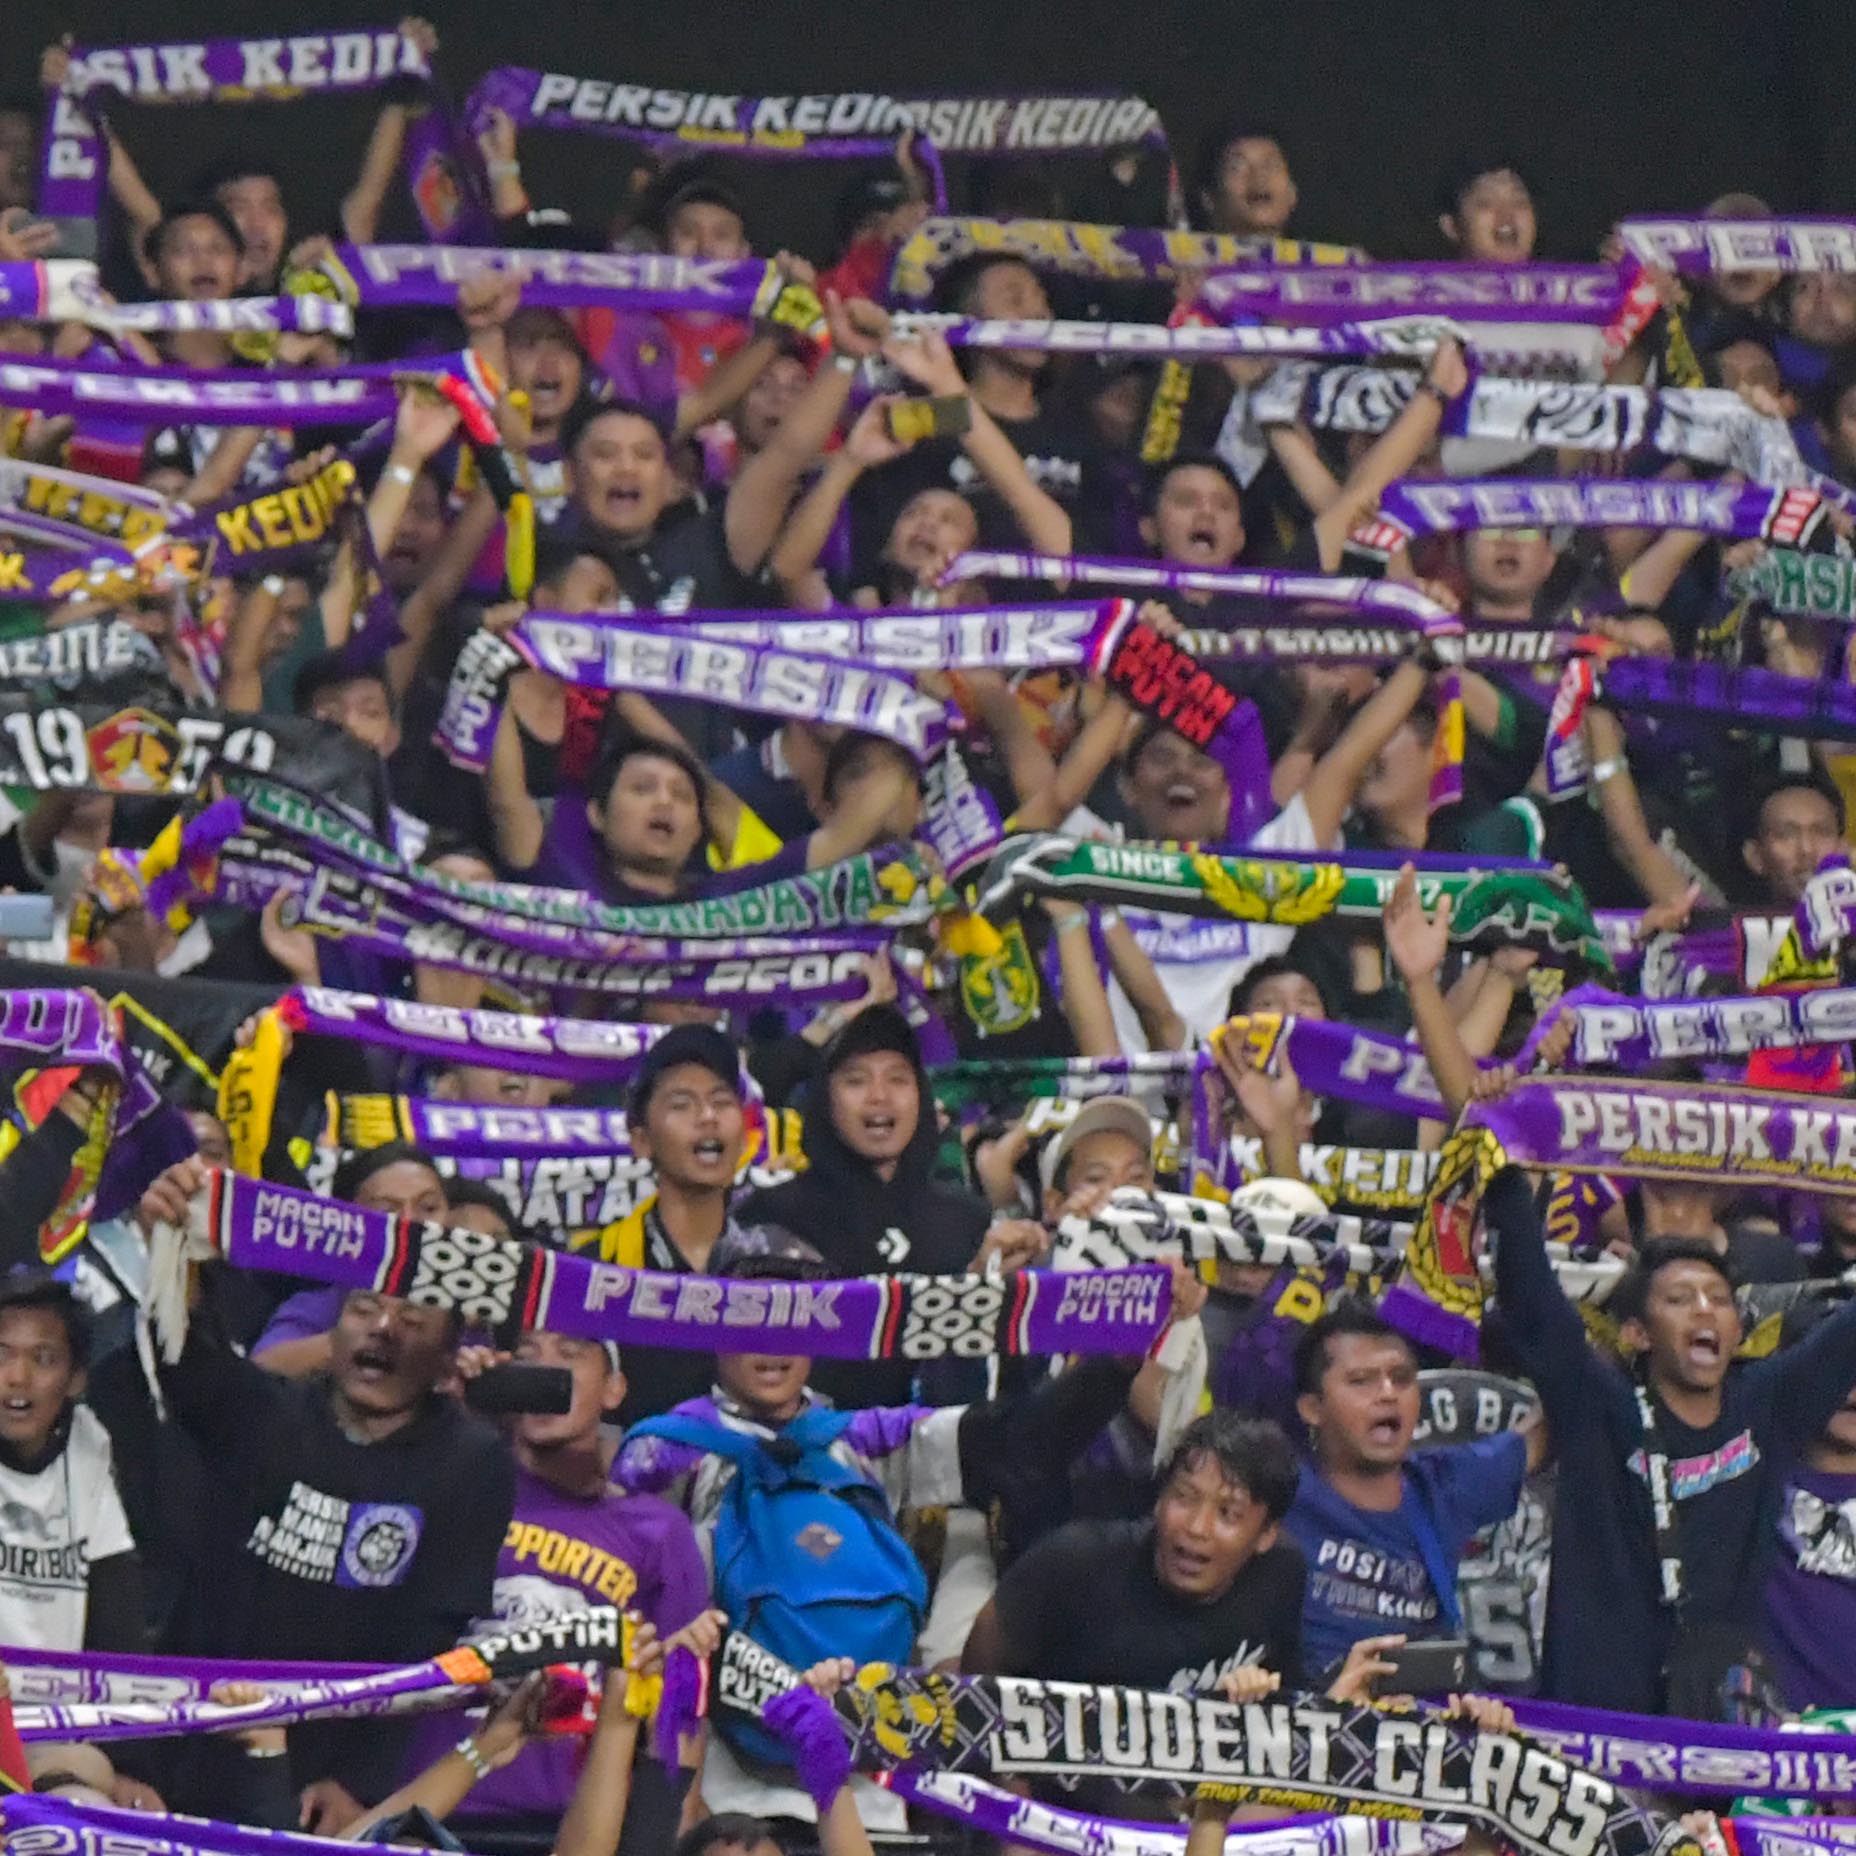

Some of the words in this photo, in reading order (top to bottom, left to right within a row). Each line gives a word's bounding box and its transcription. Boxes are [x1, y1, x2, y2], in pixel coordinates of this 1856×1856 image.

[530, 73, 741, 134] PERSIK
[363, 245, 738, 295] PERSIK
[1401, 480, 1739, 527] PERSIK
[522, 618, 943, 751] PERSIK
[7, 708, 87, 786] 19
[1088, 848, 1182, 879] SINCE
[1559, 1091, 1772, 1160] PERSIK
[256, 1190, 367, 1229] MACAN
[252, 1220, 364, 1257] PUTIH
[585, 1264, 841, 1329] PERSIK
[1056, 1297, 1156, 1323] PUTIH
[1064, 1276, 1161, 1299] MACAN
[503, 1520, 638, 1602] PPORTER
[481, 1617, 618, 1661] PUTIH
[1003, 1684, 1330, 1782] STUDENT
